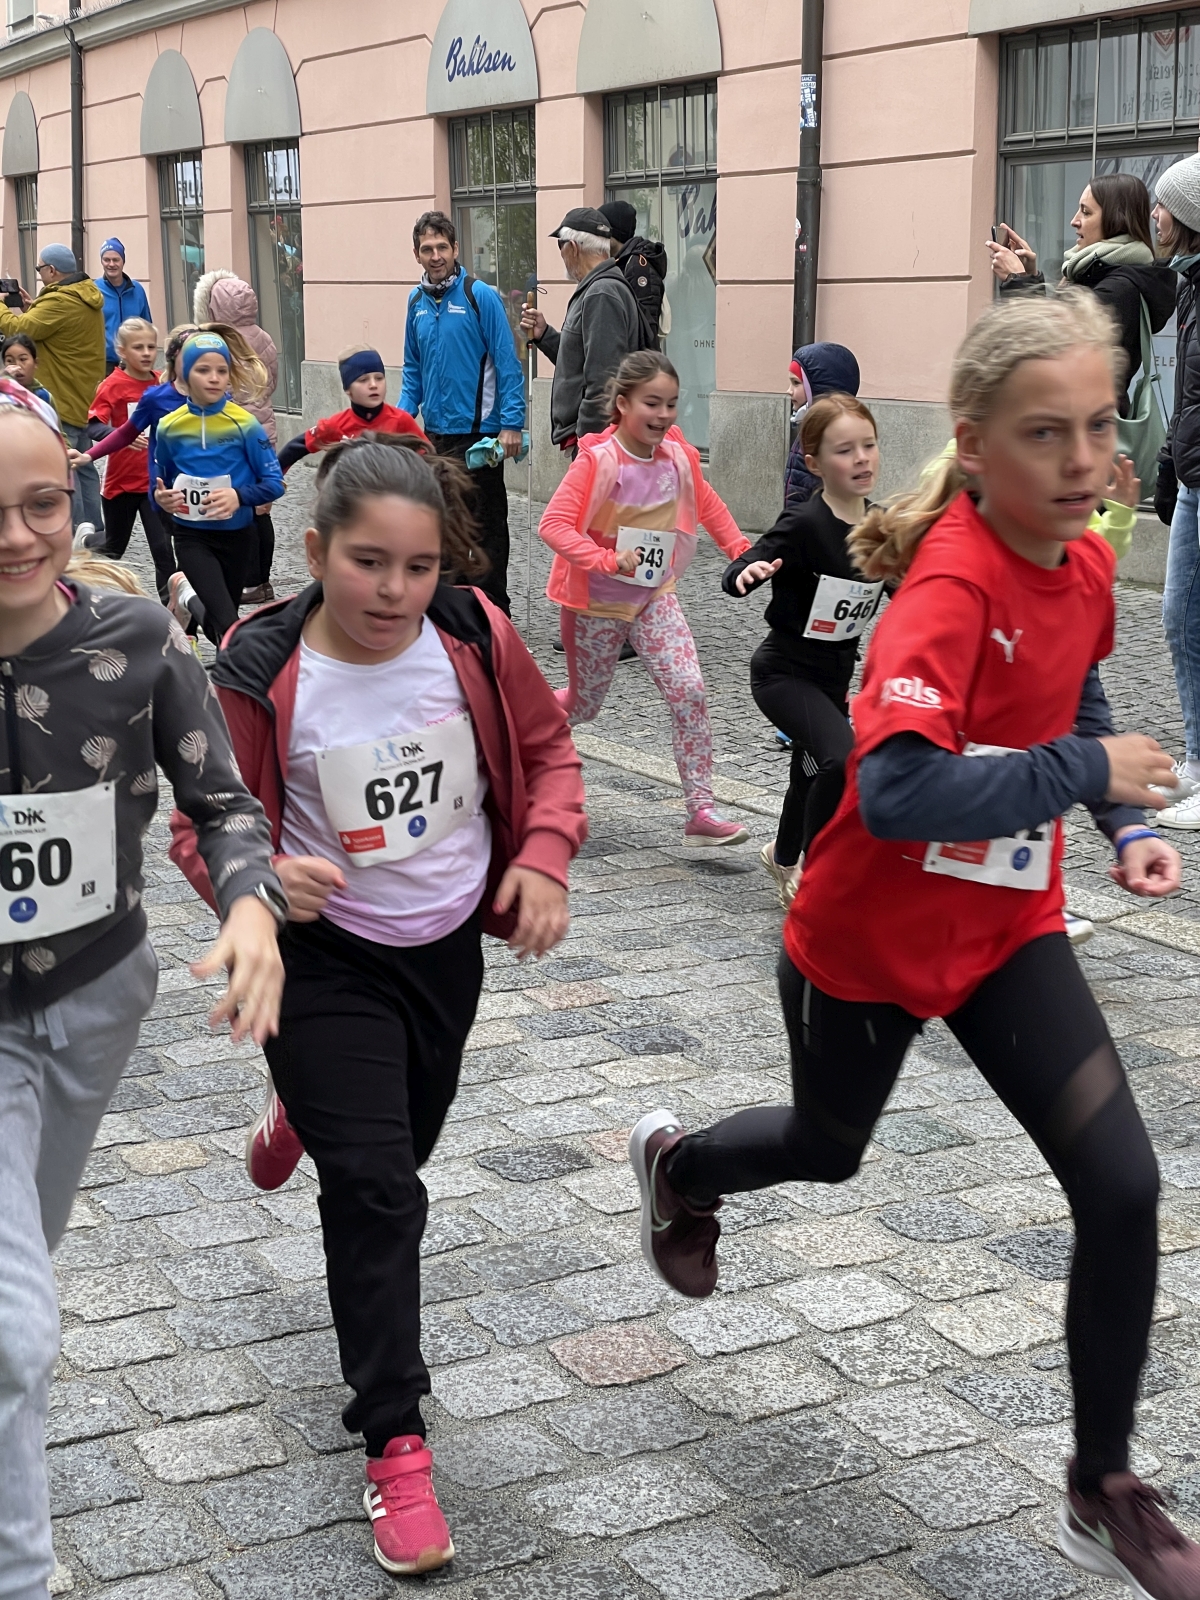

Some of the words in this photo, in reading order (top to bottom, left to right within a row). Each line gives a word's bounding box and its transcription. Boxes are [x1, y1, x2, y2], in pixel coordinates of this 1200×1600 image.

[445, 34, 516, 82] Bahlsen
[694, 340, 715, 348] OHNE
[635, 546, 664, 568] 643
[834, 599, 874, 621] 646
[365, 760, 444, 821] 627
[0, 837, 72, 892] 60
